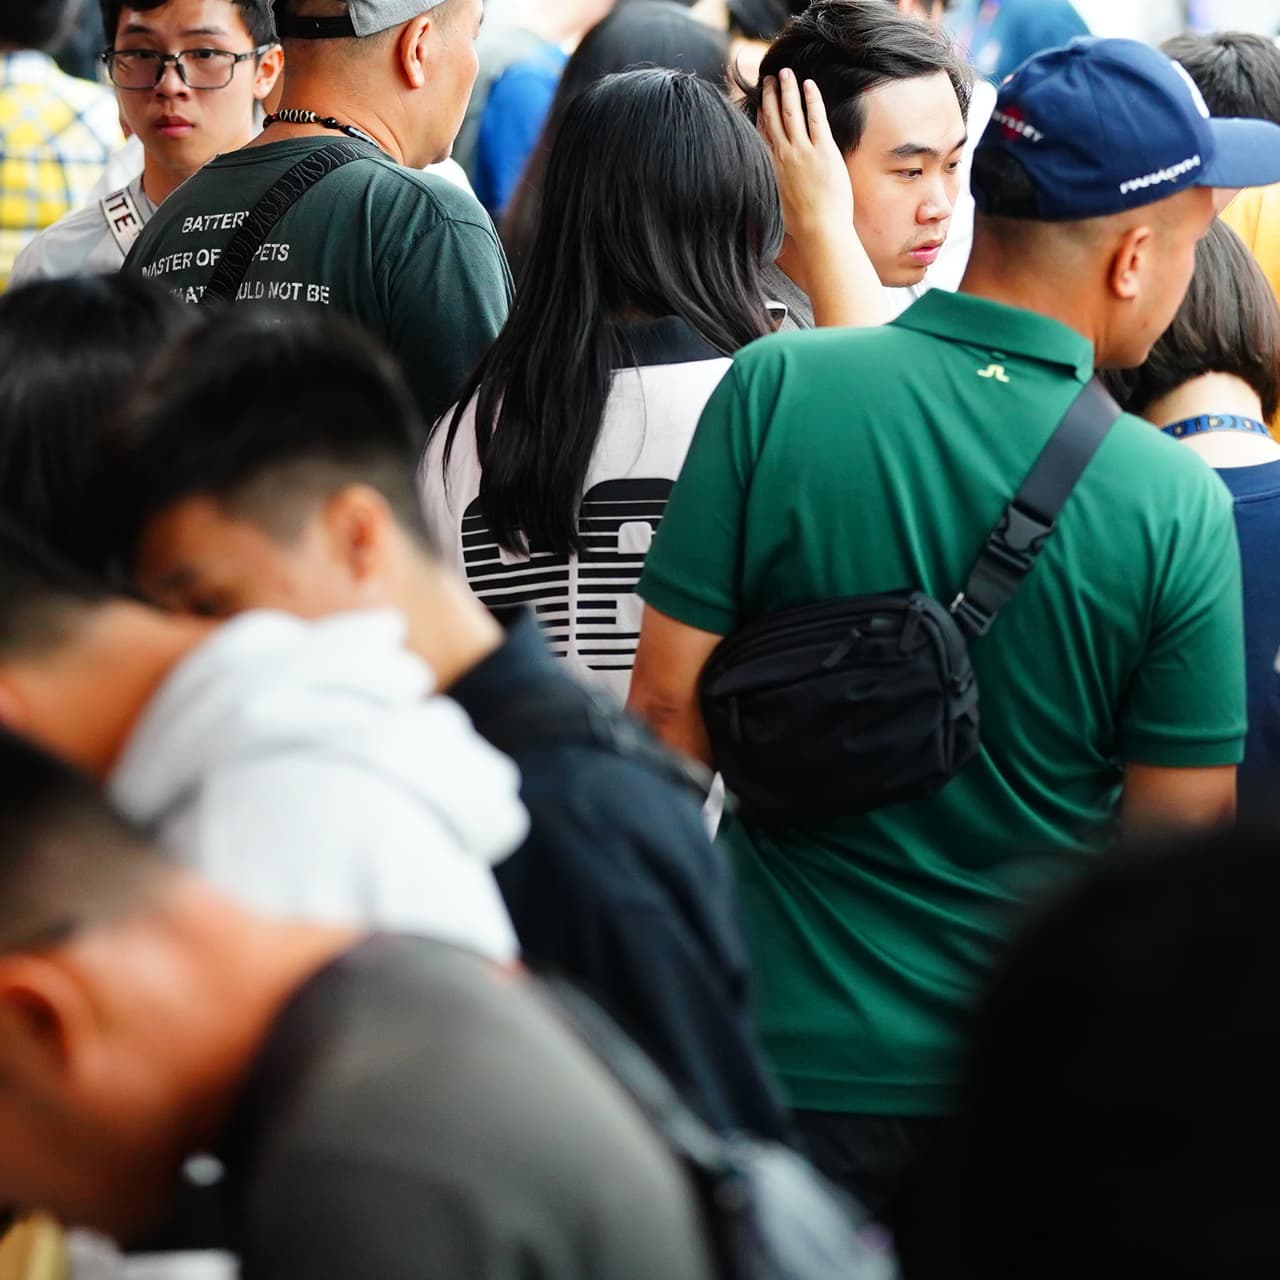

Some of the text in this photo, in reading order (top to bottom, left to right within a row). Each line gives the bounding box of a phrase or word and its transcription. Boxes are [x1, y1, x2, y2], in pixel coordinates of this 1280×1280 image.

[196, 248, 222, 267] OF
[268, 281, 303, 301] NOT
[306, 284, 331, 305] BE
